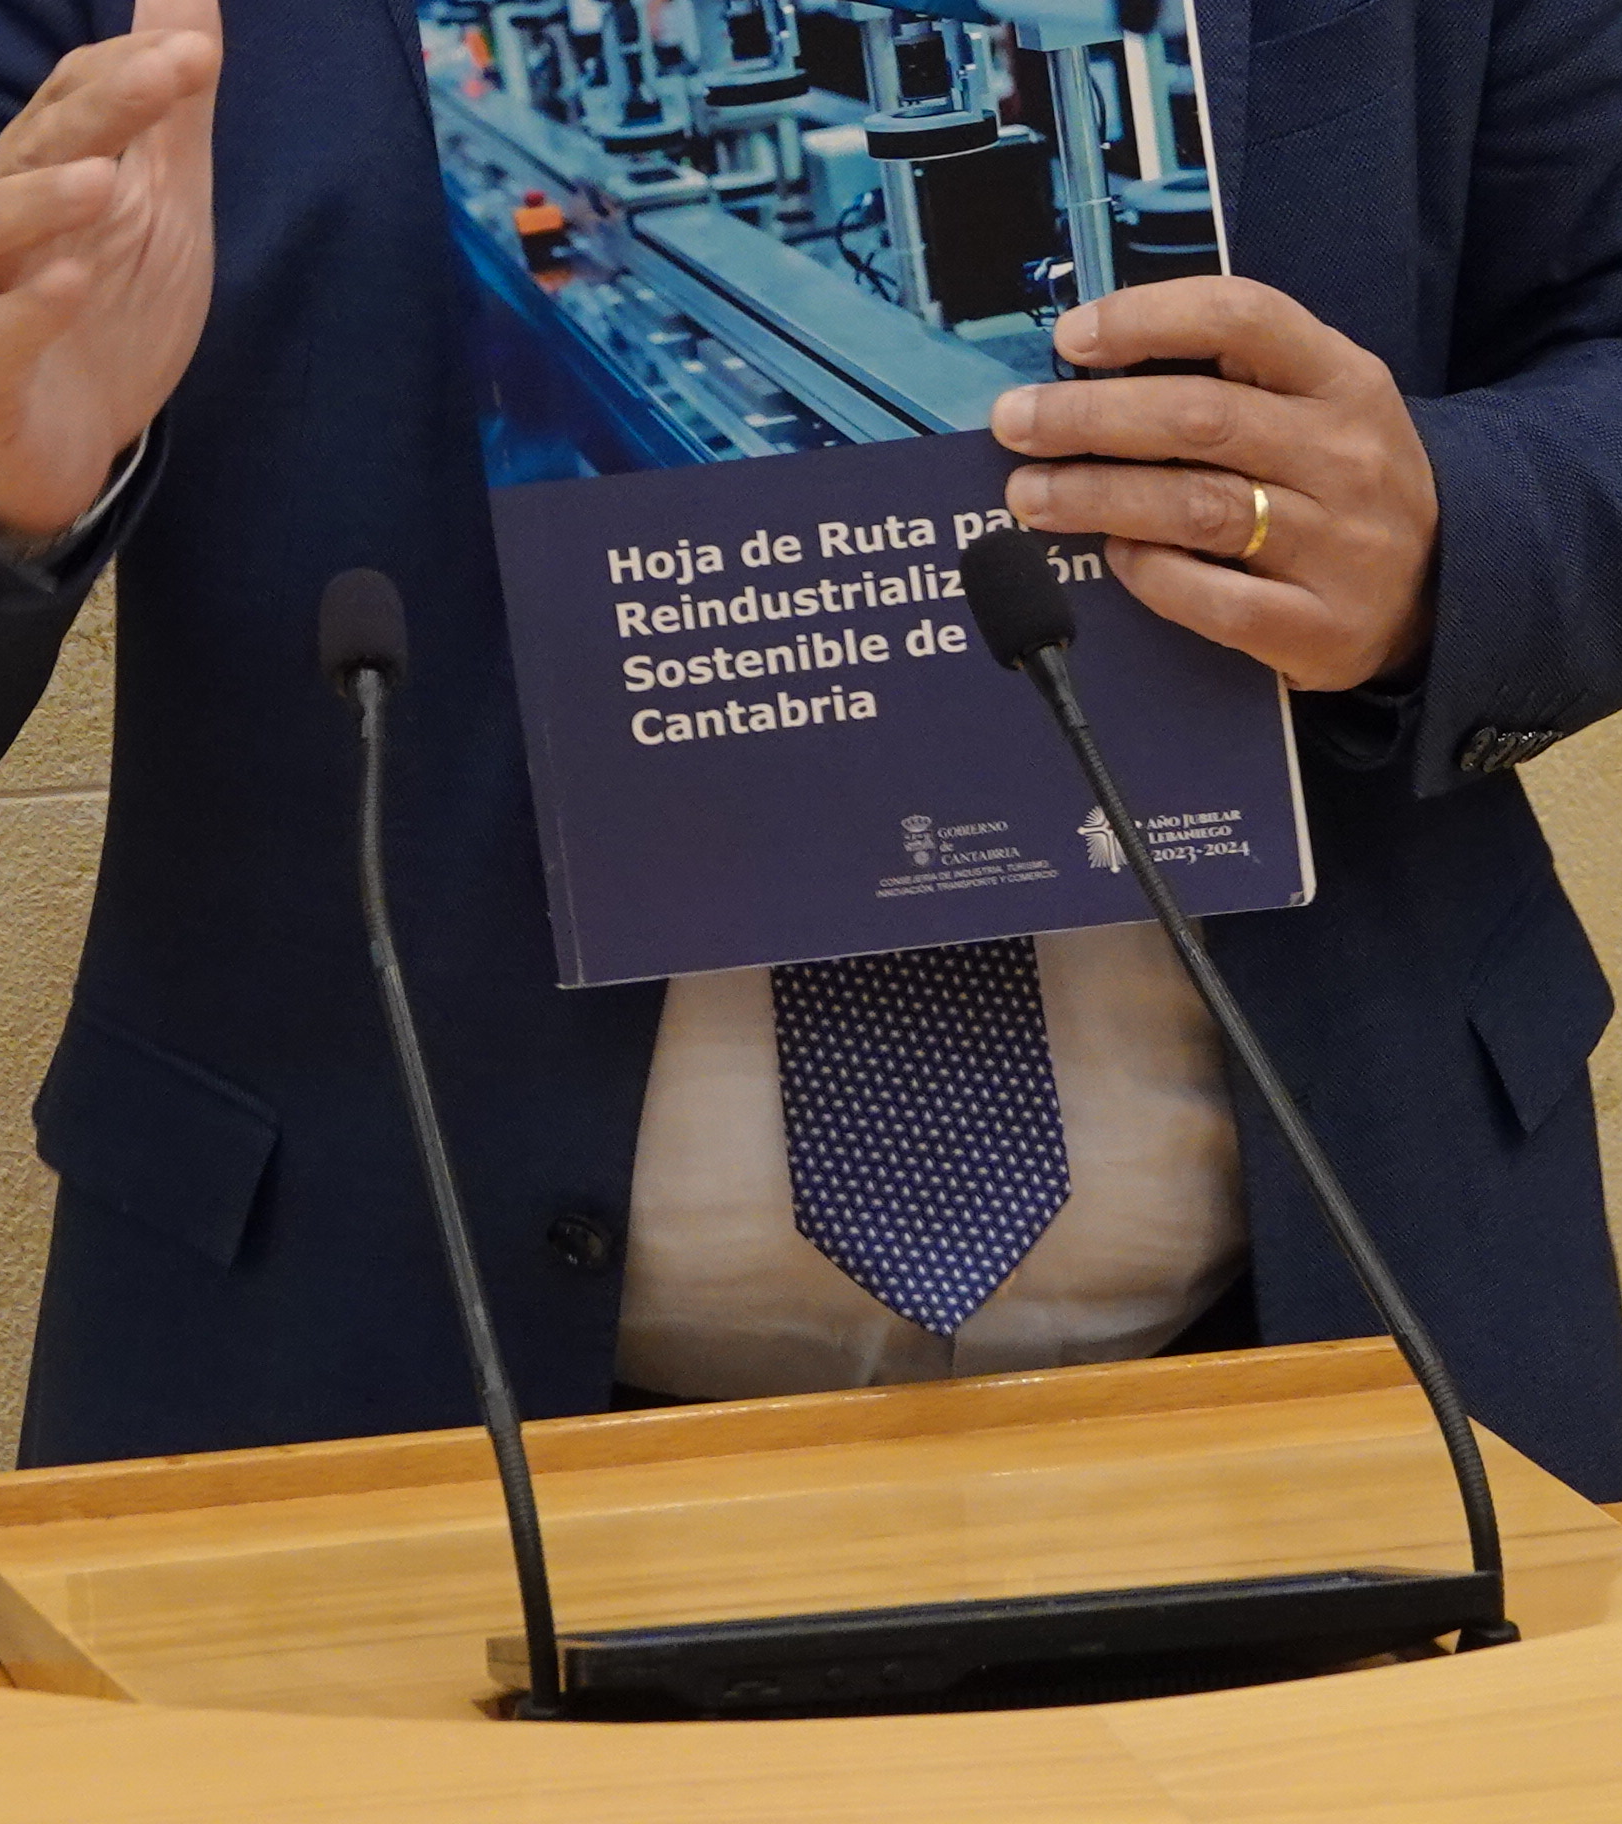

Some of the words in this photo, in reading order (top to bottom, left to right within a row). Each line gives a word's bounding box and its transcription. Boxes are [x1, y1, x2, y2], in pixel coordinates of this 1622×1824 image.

[607, 539, 724, 585] Hoja
[740, 529, 802, 568] de
[818, 515, 936, 558] Ruta
[953, 507, 1030, 550] pa
[623, 628, 890, 692] Sostenible
[905, 619, 967, 657] de
[631, 685, 877, 746] Cantabria
[937, 820, 1009, 839] GOBIERNO
[1146, 815, 1180, 830] AÑO
[1147, 825, 1233, 844] LEBANIEGO
[941, 846, 1021, 866] CANTABRIA
[1150, 841, 1250, 865] 2023-2024
